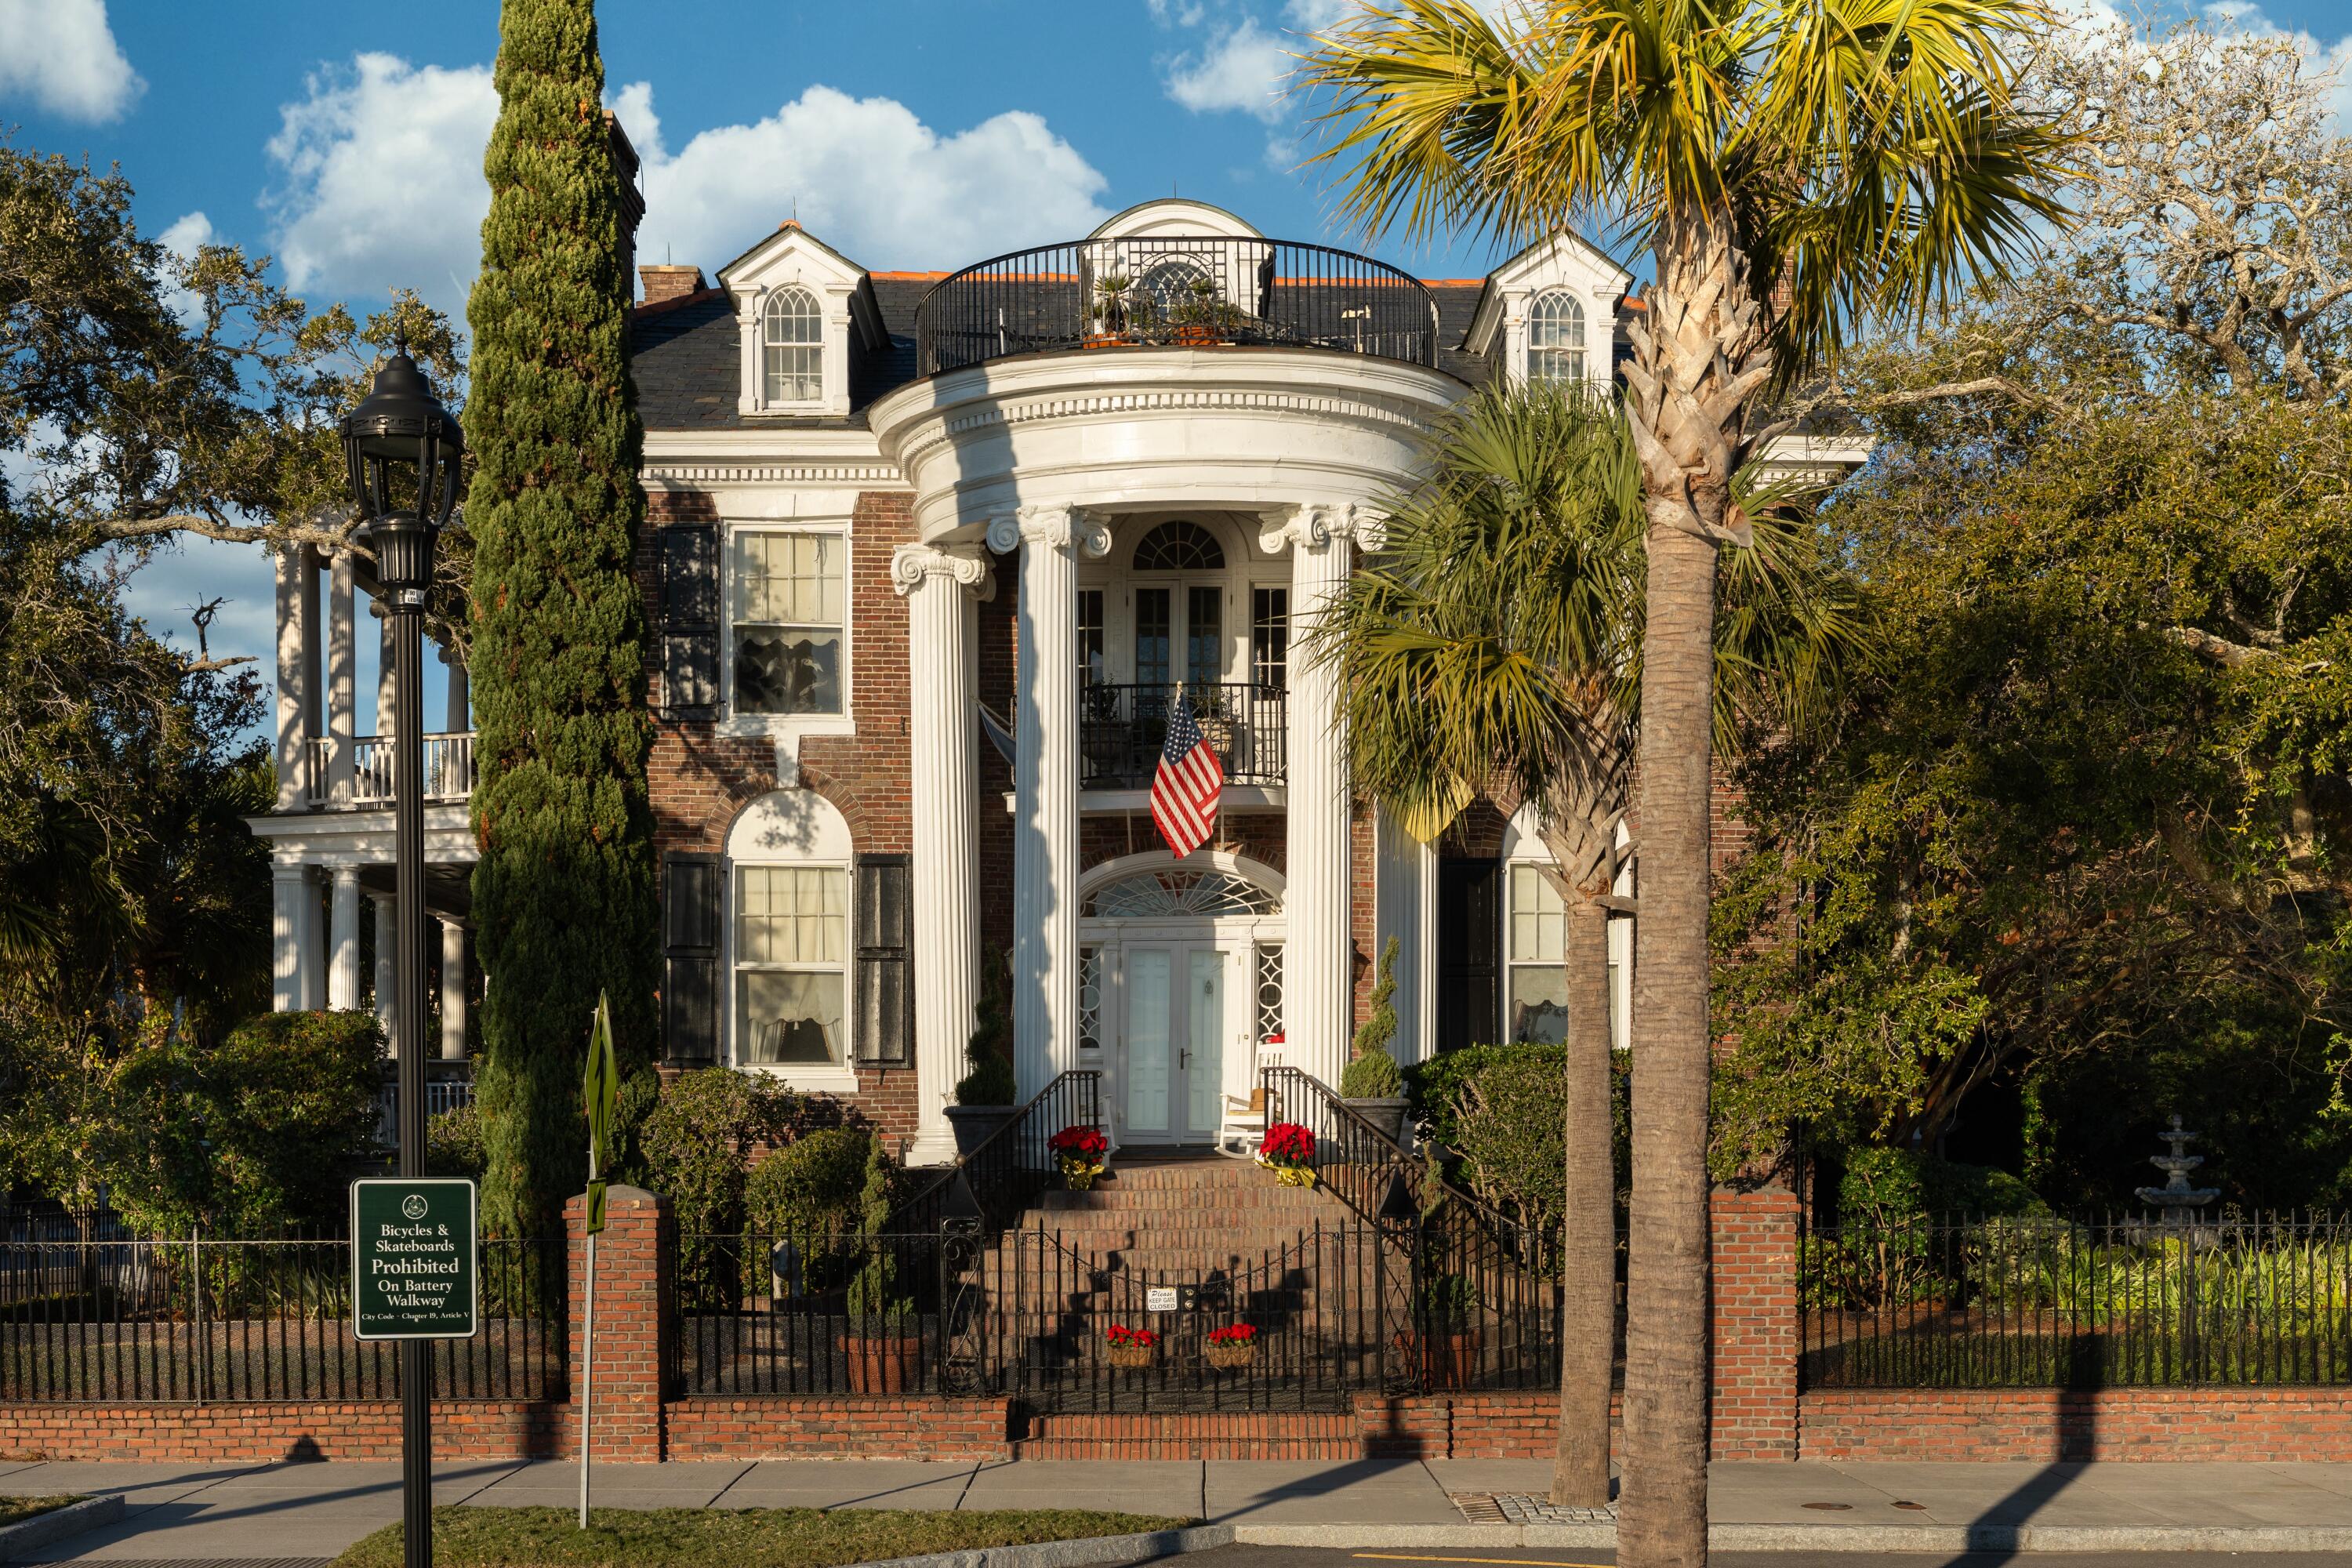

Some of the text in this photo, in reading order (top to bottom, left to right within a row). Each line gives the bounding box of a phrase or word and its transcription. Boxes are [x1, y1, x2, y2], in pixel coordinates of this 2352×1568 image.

[381, 1224, 450, 1239] Bicycles &
[376, 1240, 455, 1252] Skateboards
[372, 1258, 459, 1274] Prohibited
[378, 1279, 453, 1294] On Battery
[386, 1294, 445, 1308] Walkway
[401, 1312, 427, 1321] Chapter
